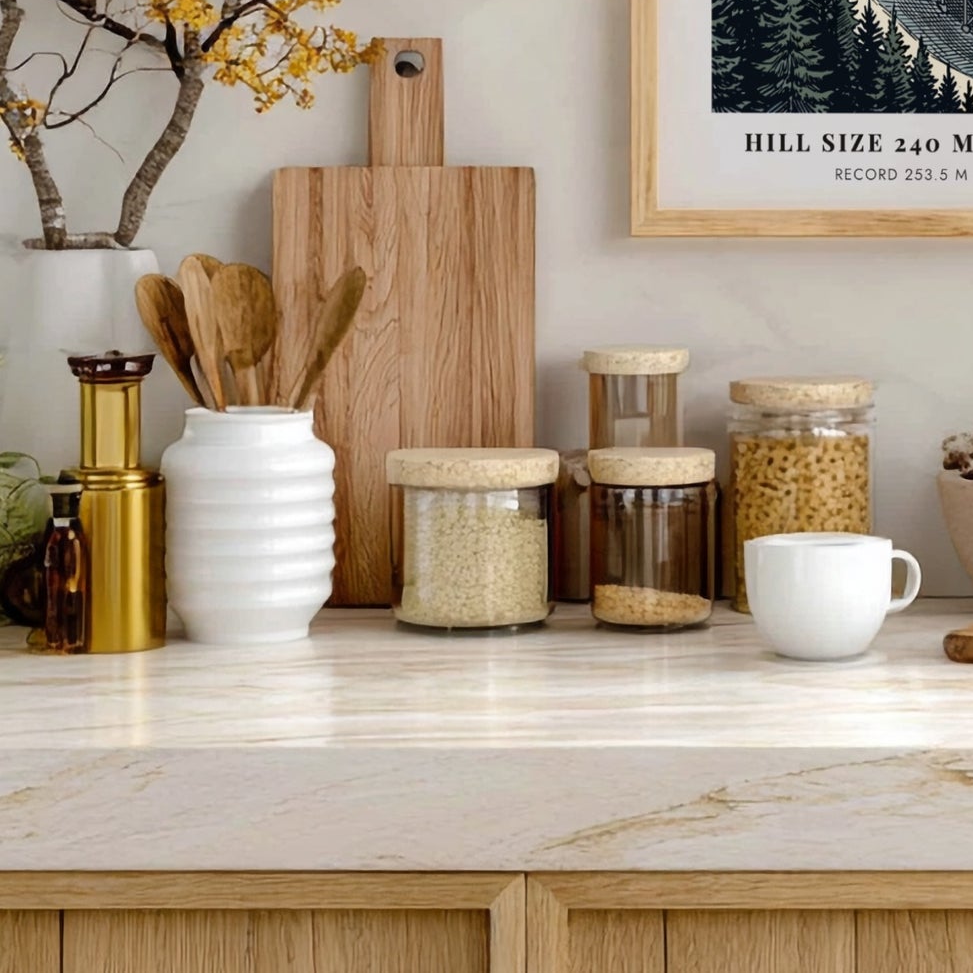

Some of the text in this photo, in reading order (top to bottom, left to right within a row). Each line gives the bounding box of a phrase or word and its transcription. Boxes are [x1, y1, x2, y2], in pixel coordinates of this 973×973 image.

[744, 133, 811, 153] HILL
[822, 133, 883, 153] SIZE
[894, 137, 940, 156] 240
[952, 133, 973, 153] M
[835, 167, 898, 181] RECORD
[904, 168, 948, 181] 253.5
[955, 168, 968, 181] M
